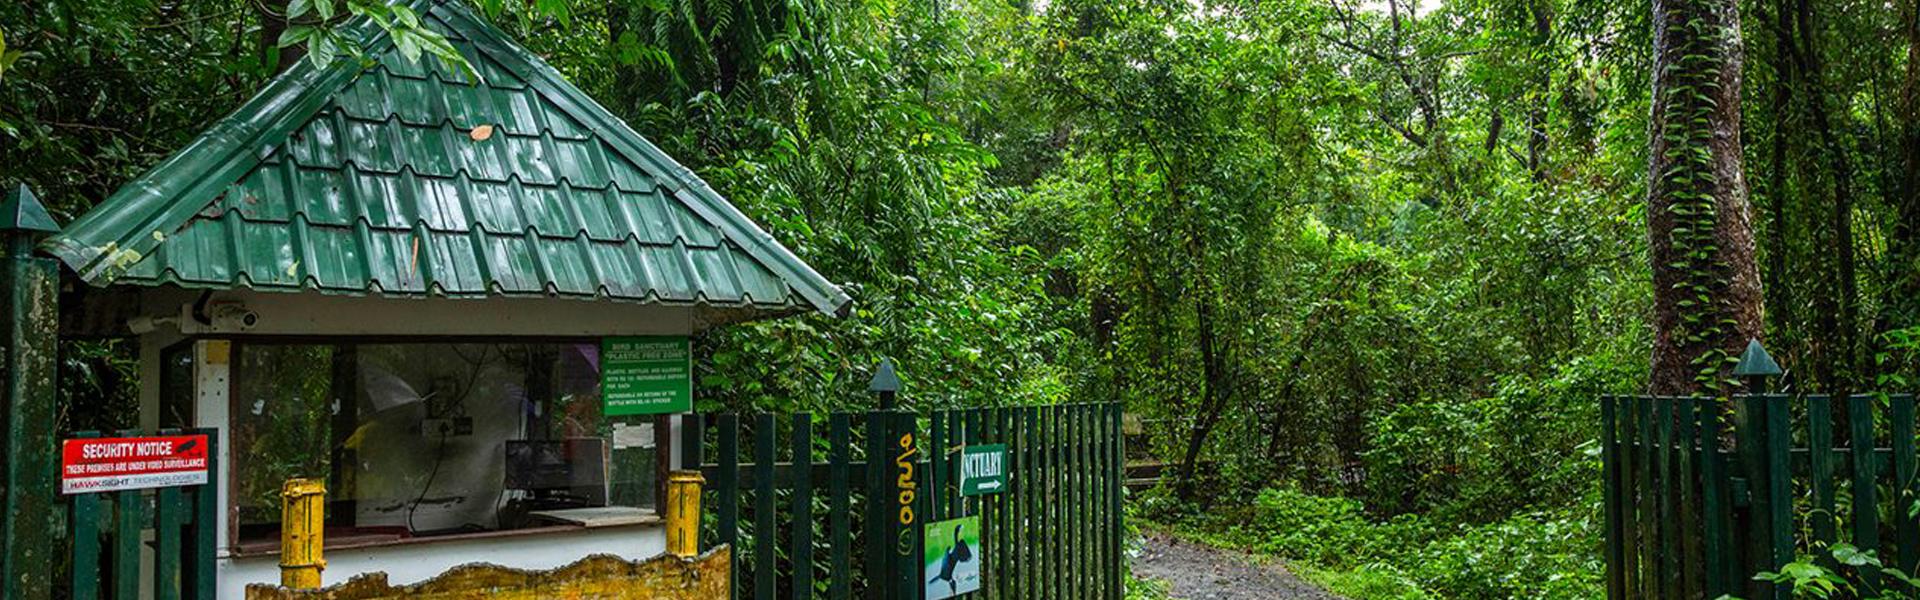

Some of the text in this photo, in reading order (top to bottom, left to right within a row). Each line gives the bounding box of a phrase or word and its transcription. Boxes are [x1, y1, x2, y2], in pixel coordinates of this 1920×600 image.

[635, 342, 679, 350] SANCTUARY
[83, 441, 173, 459] SECURITY NOTICE
[66, 458, 205, 474] THESE PREMISES ARE UNDER VIDEO SURVEILLANCE
[70, 478, 129, 489] HAWKSIGHT
